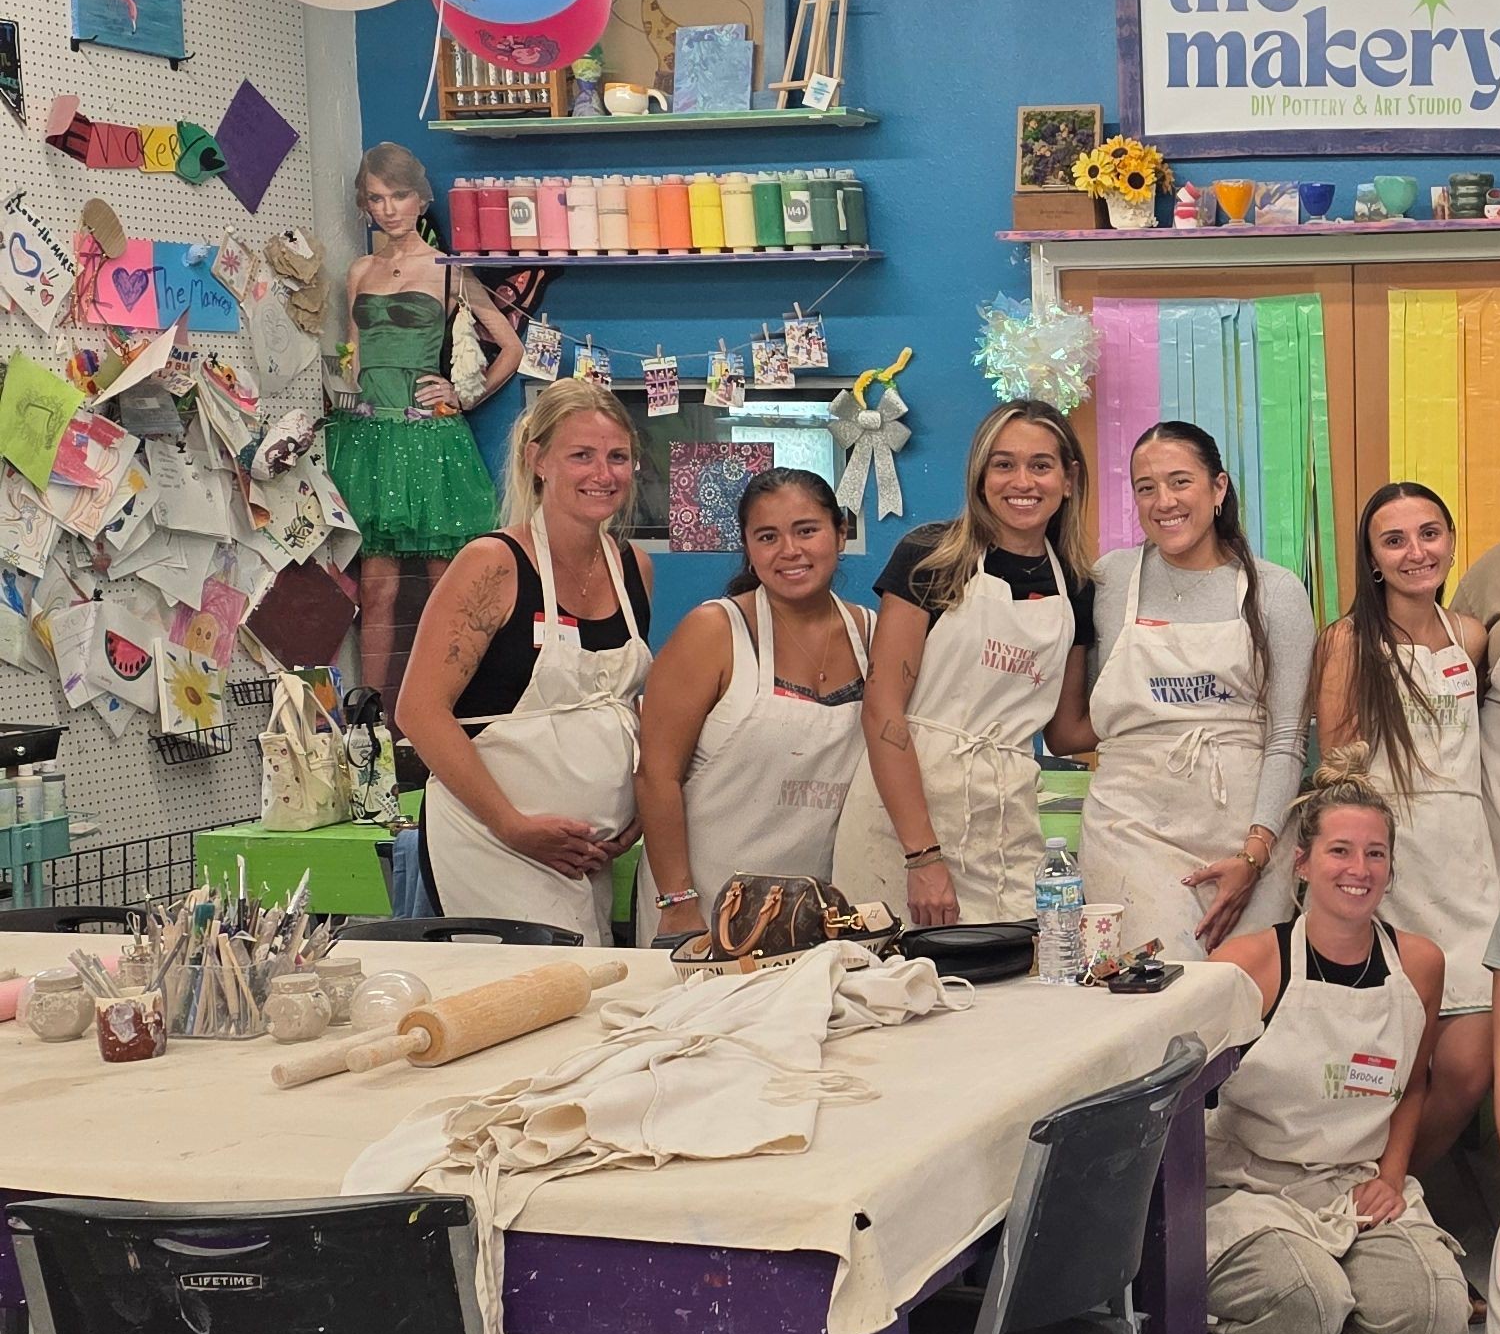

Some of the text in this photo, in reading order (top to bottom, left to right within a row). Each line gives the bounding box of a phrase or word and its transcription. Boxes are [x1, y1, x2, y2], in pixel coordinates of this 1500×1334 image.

[1251, 95, 1277, 117] DIY
[1353, 95, 1368, 115] &
[1373, 95, 1402, 115] ART
[1408, 94, 1463, 115] STUDIO
[511, 207, 530, 220] M11
[981, 650, 1035, 676] MAKER
[1149, 673, 1216, 688] MOTIVATED
[1151, 682, 1217, 704] MAKER
[189, 1276, 254, 1286] LIFETIME
